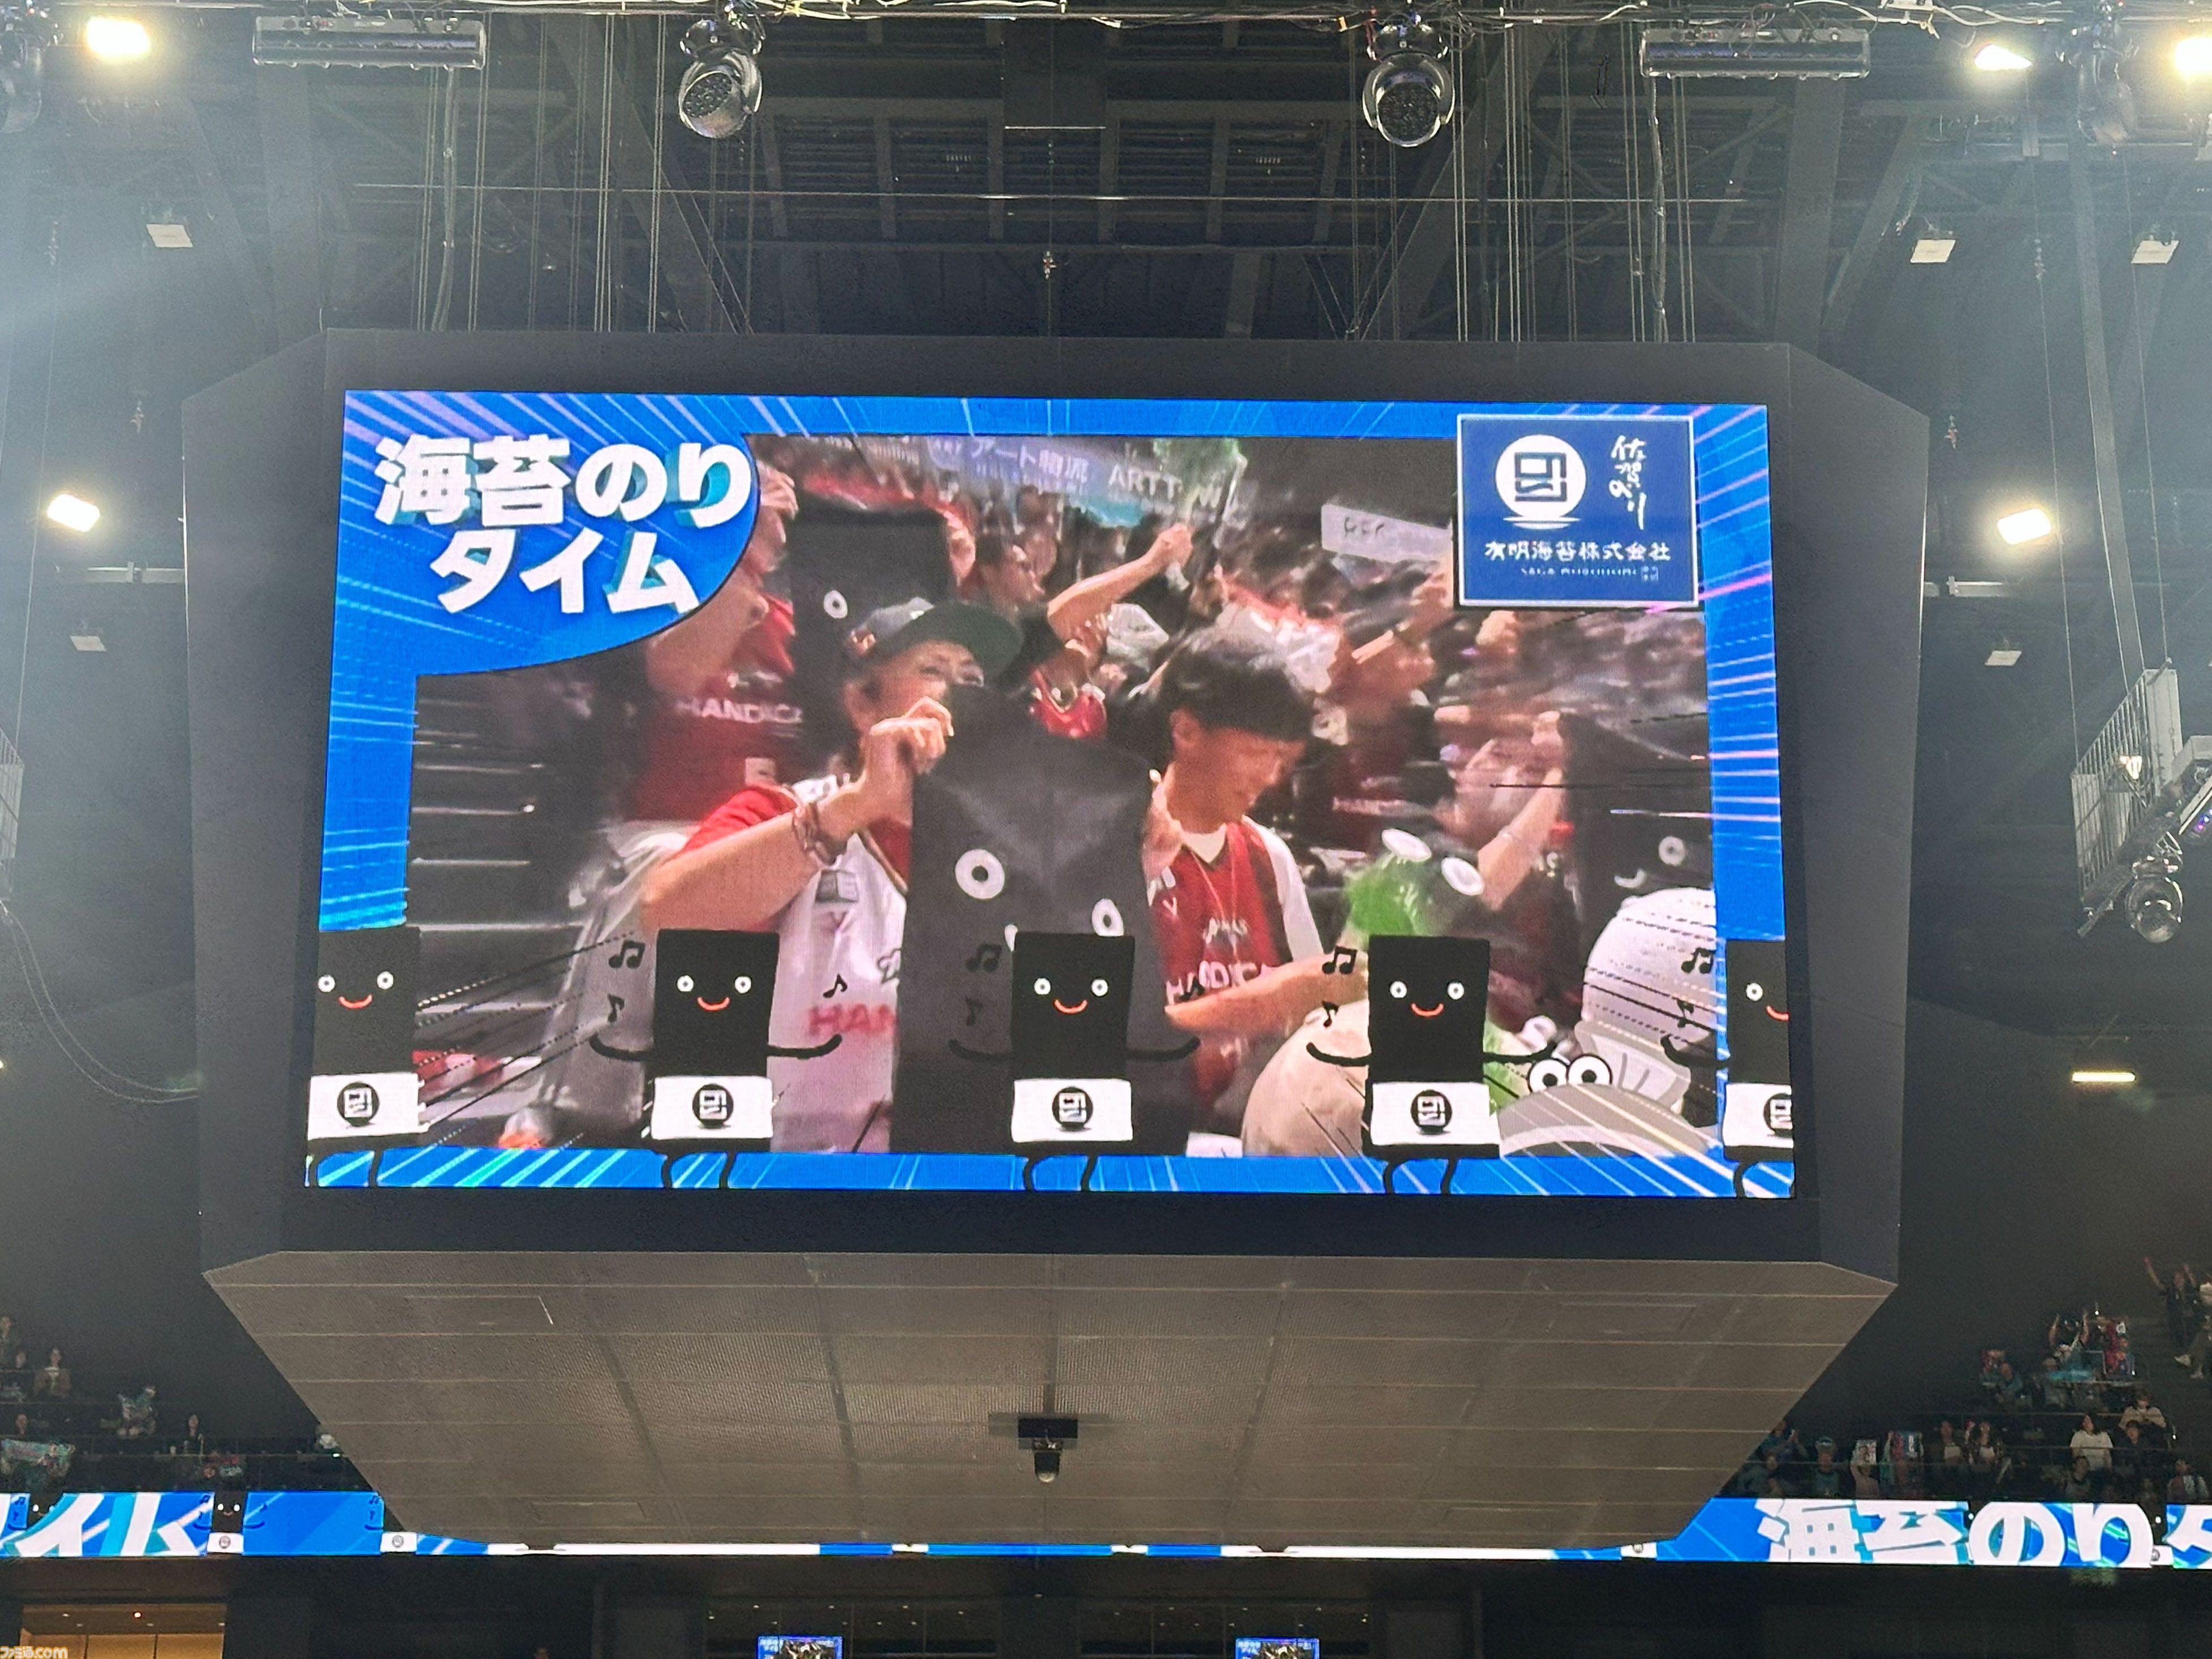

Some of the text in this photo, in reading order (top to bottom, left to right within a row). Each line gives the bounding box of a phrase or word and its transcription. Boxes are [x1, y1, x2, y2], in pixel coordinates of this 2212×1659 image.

[374, 433, 751, 529] 海苔のり
[429, 527, 700, 614] タイム
[1484, 540, 1671, 562] 有明海苔株式会社
